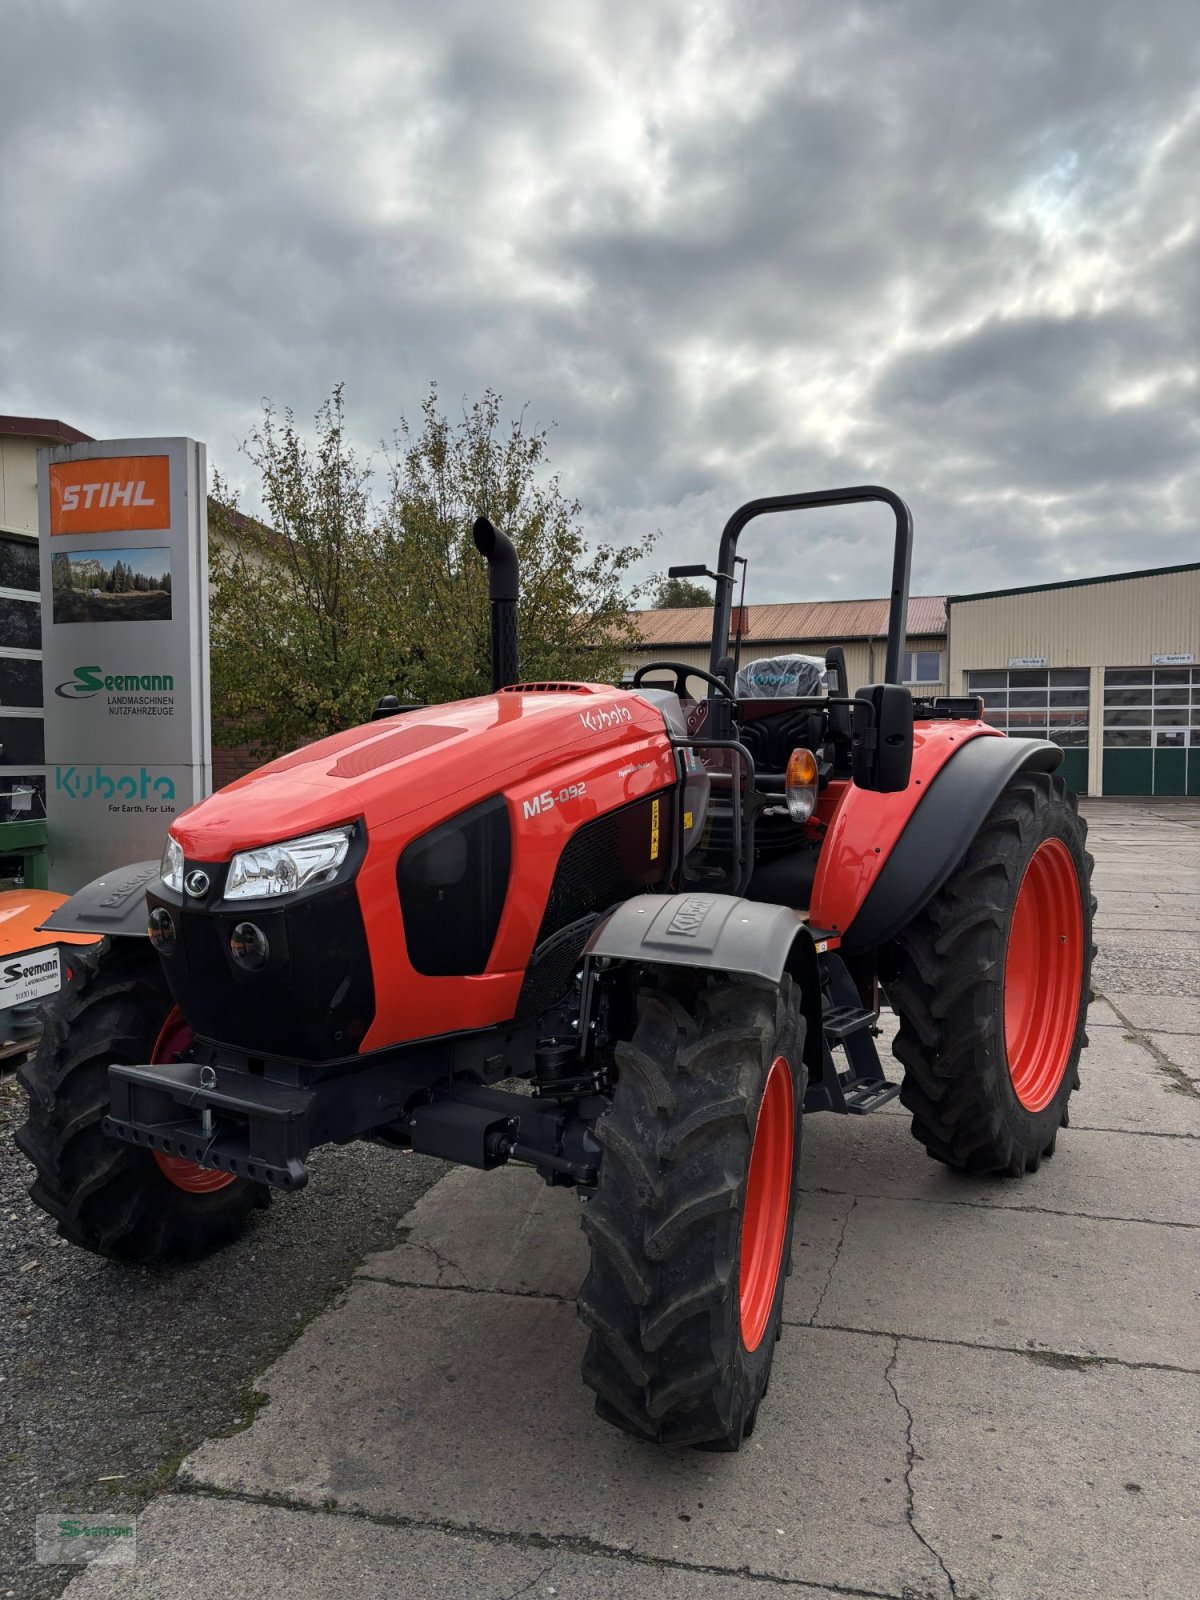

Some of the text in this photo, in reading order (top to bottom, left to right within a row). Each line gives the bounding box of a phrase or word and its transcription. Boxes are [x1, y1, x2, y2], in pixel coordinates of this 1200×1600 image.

[61, 480, 155, 512] STIHL
[73, 666, 174, 692] Seemann
[107, 696, 174, 706] LANDMASCHINEN
[108, 707, 174, 716] NUTZFAHRZEUGE
[579, 704, 632, 732] Kubota
[55, 767, 175, 800] Kubota
[108, 804, 175, 814] For Earth, For Life
[522, 781, 587, 820] M5-092
[4, 959, 58, 984] Seemann
